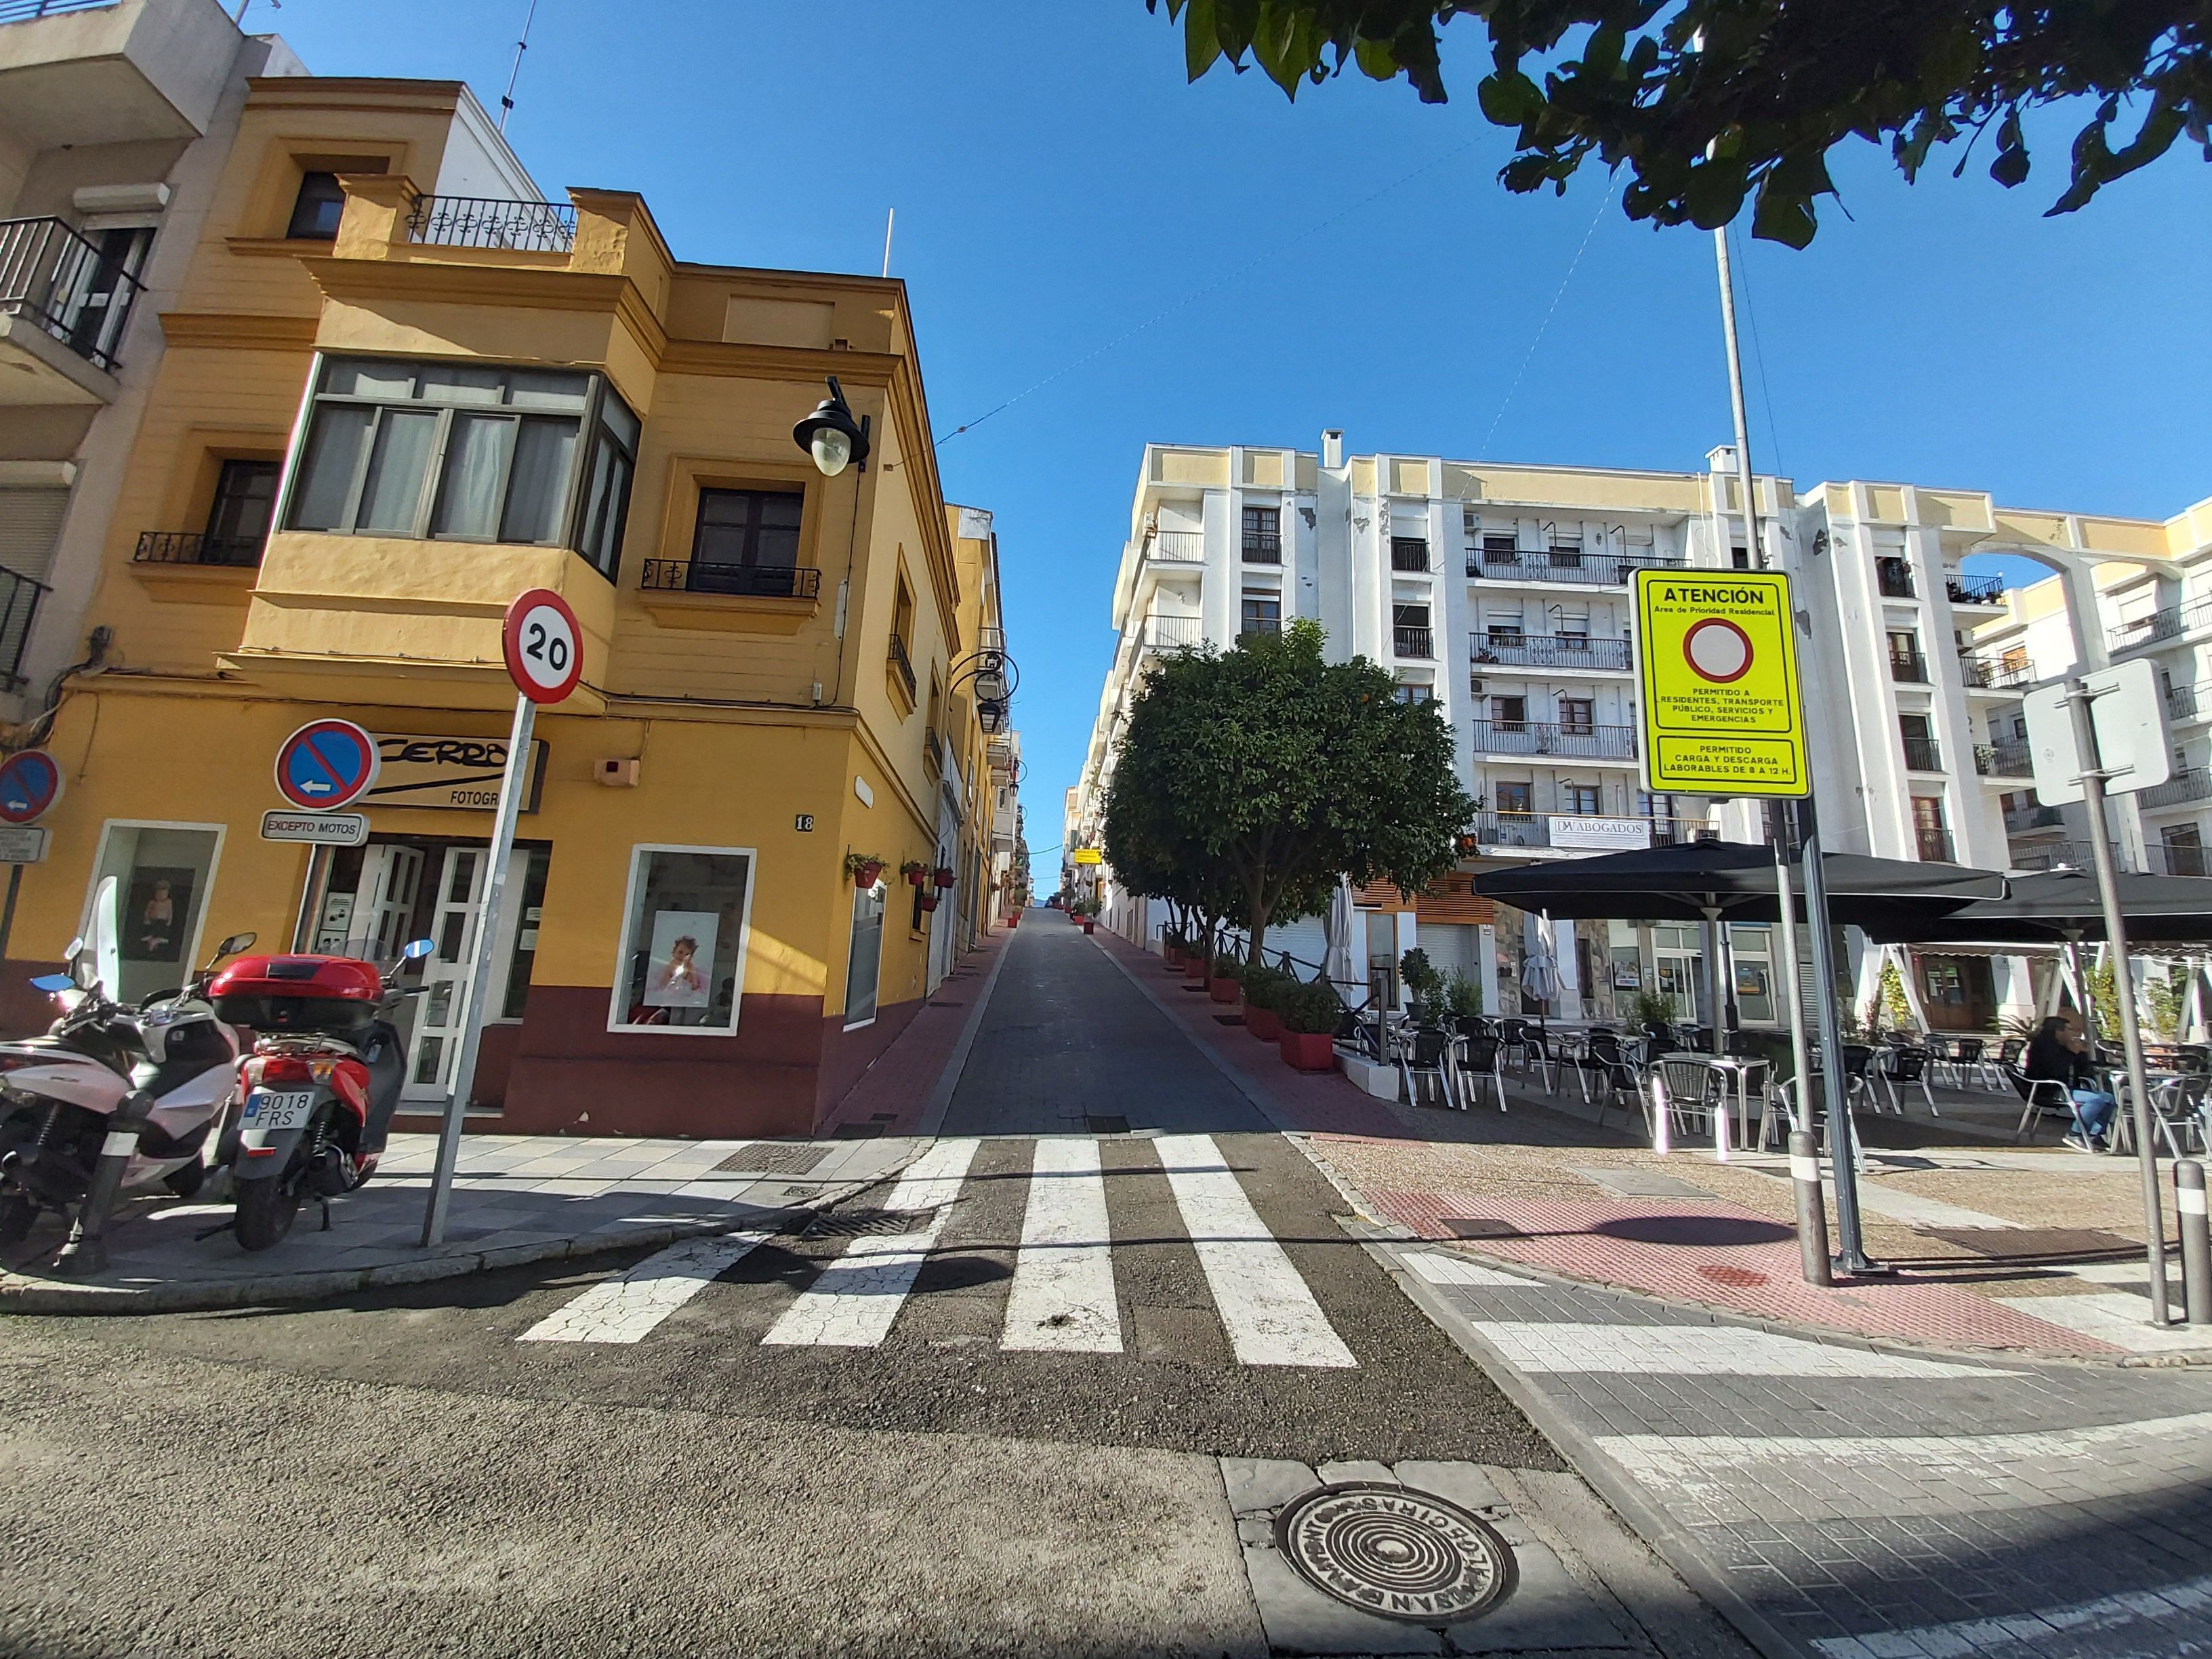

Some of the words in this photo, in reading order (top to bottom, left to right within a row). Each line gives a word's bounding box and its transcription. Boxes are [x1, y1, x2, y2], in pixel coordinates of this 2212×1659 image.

[1664, 587, 1764, 604] ATENCIÓN
[527, 623, 567, 671] 20
[1723, 698, 1784, 706] TRANSPORTE
[1691, 715, 1756, 723] EMERGENCIAS
[1700, 745, 1752, 754] PERMITIDO
[1723, 756, 1778, 764] DESCARGA
[1664, 764, 1729, 773] LABORABLES
[450, 791, 501, 806] FOTOGR
[268, 820, 315, 832] EXCEPTO
[319, 823, 356, 835] MOTOS
[796, 815, 813, 830] 18
[1576, 822, 1642, 834] ABOGADOS
[259, 1094, 309, 1109] 9018
[255, 1111, 294, 1126] FRS
